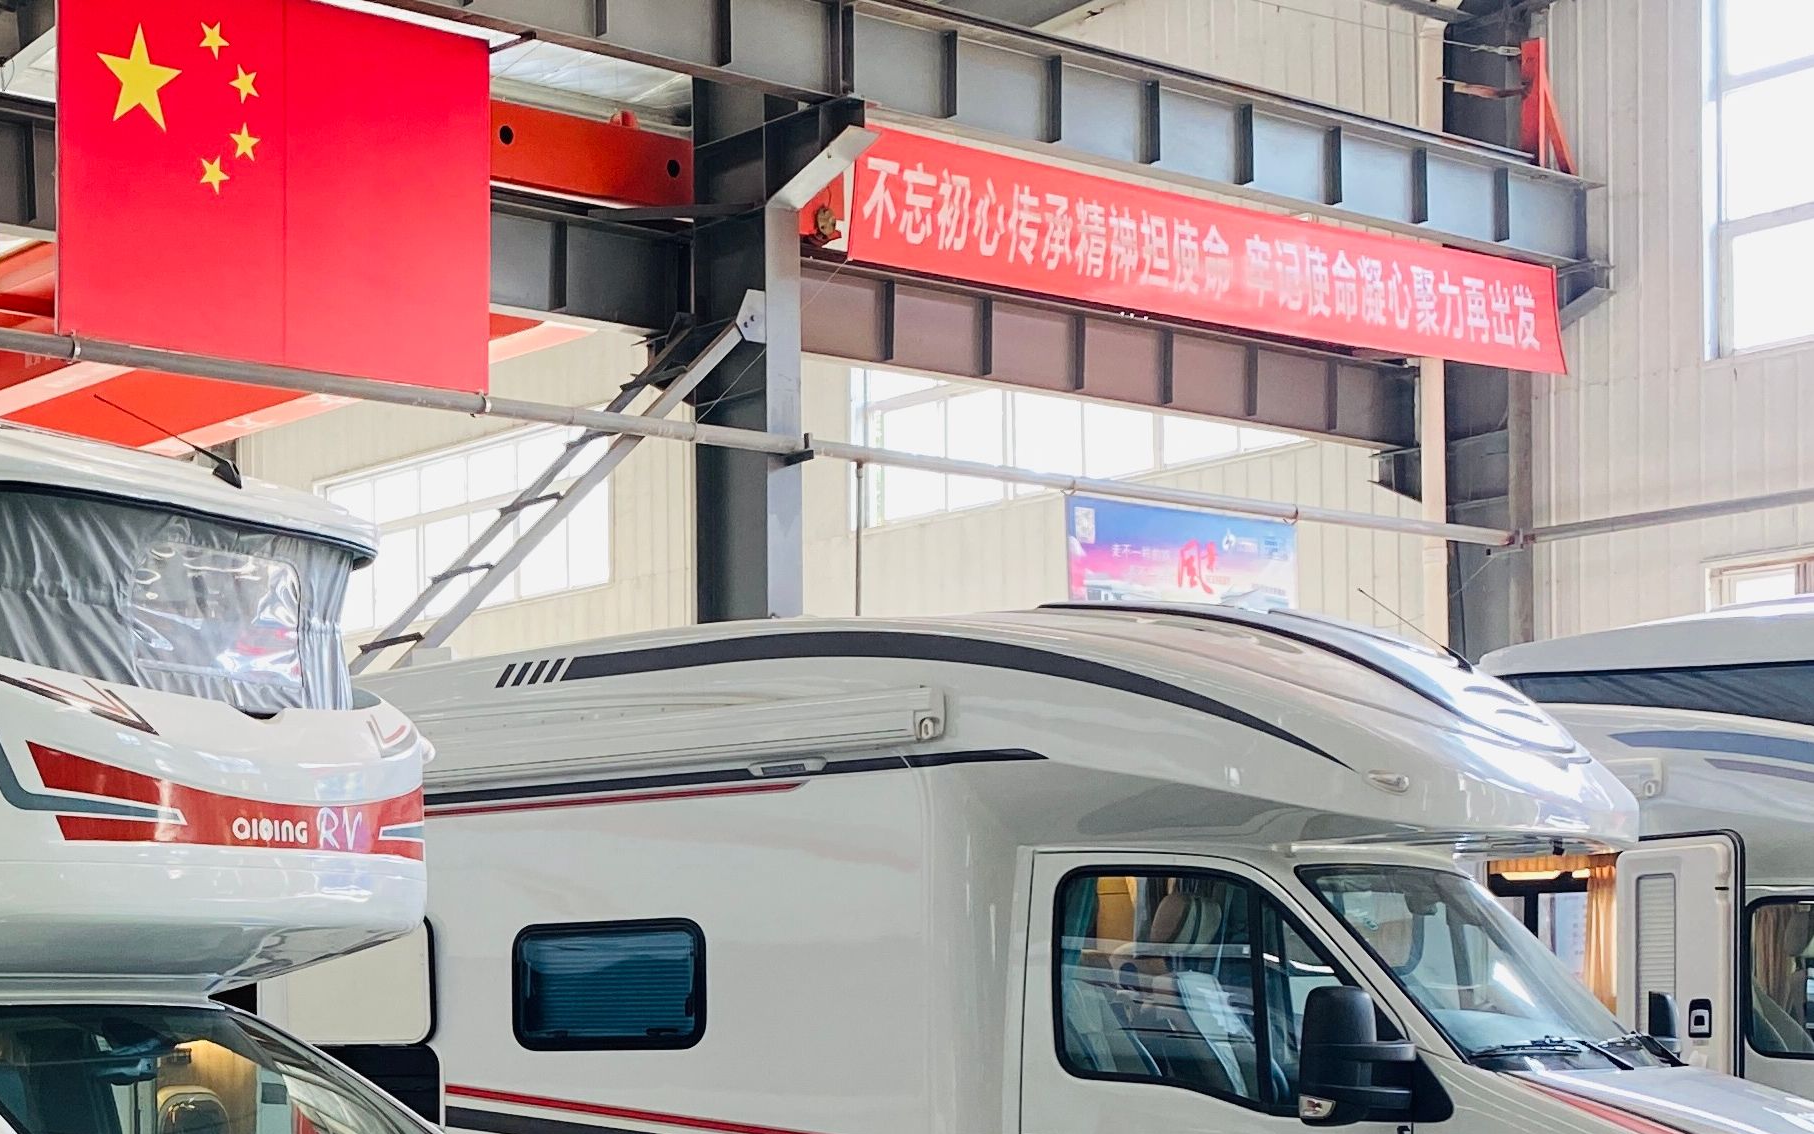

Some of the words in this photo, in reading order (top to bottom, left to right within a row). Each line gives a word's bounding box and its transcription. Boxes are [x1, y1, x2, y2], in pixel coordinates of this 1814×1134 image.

[862, 156, 1232, 300] 不忘初心传承精神担使命
[1245, 234, 1540, 351] 牢记使命凝心聚力再出发
[316, 806, 363, 851] RV
